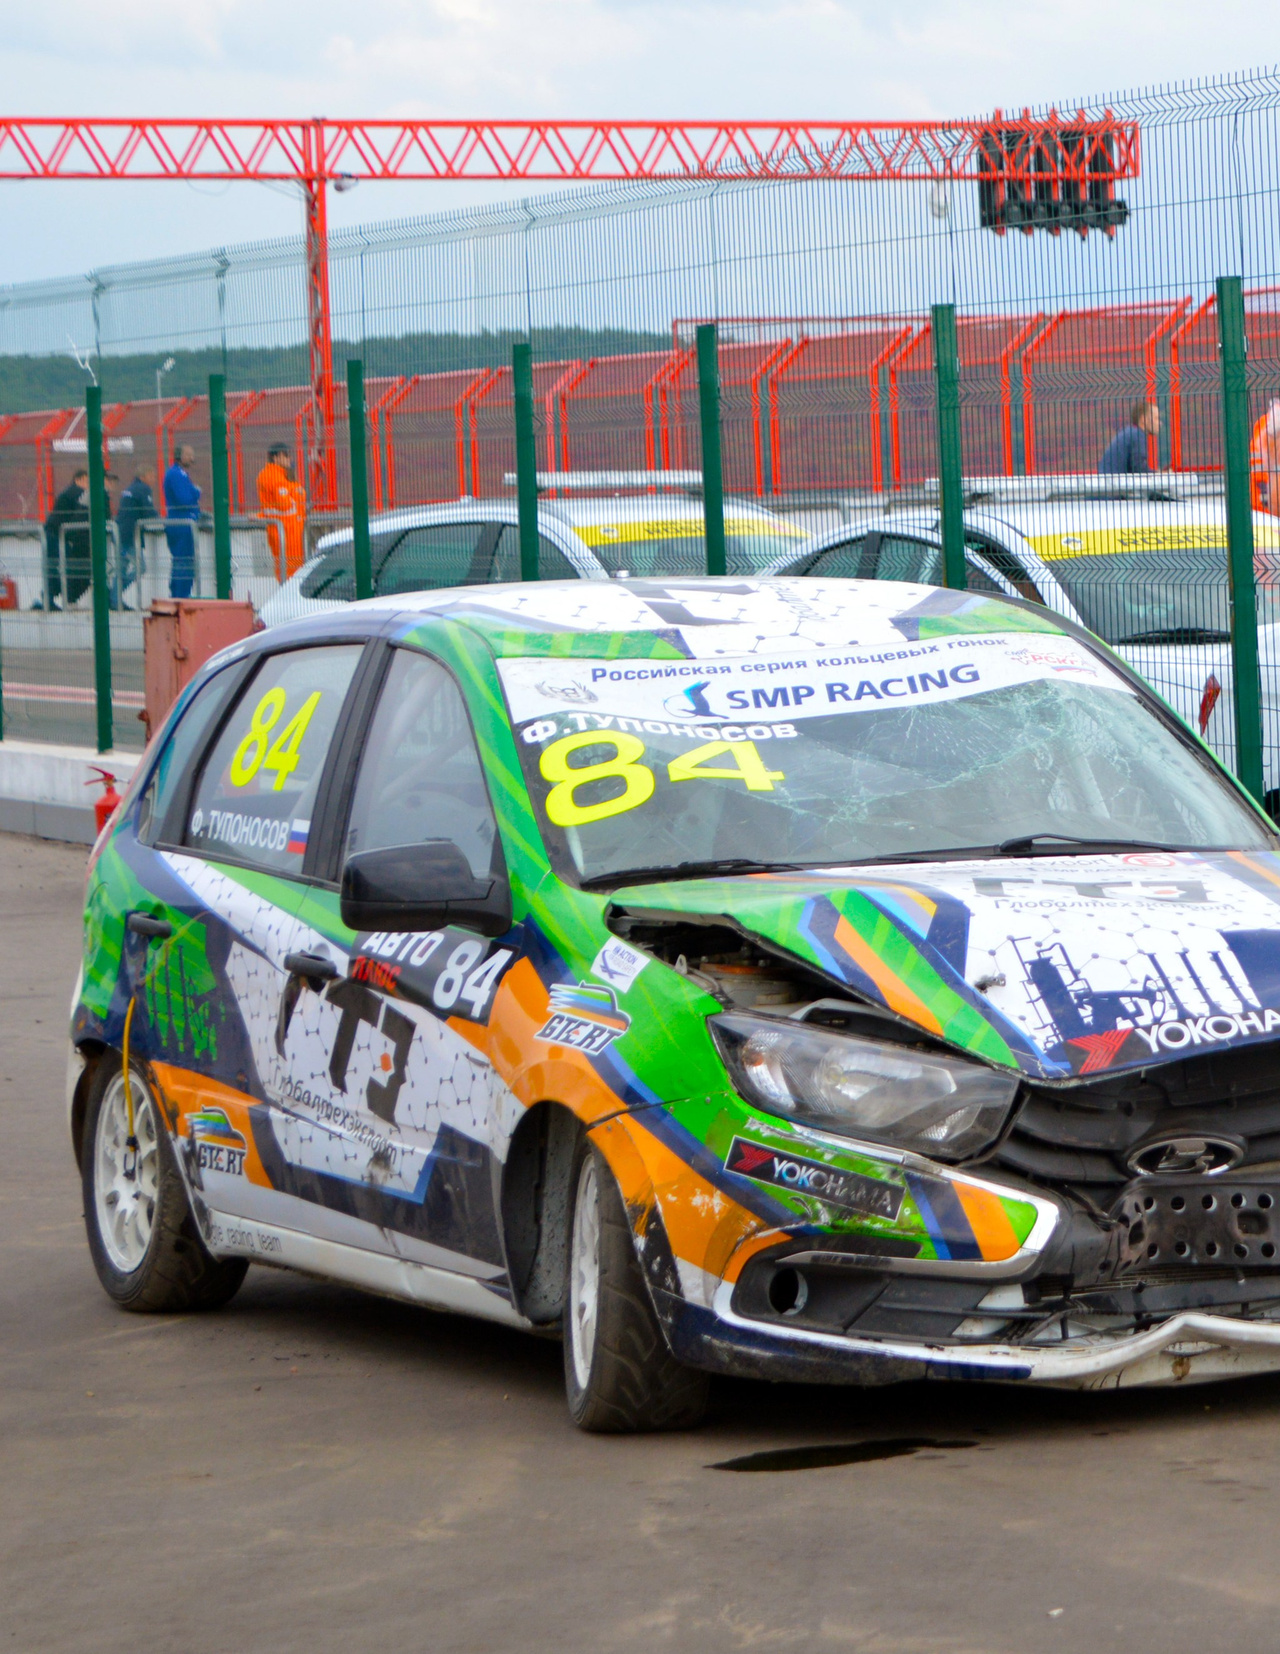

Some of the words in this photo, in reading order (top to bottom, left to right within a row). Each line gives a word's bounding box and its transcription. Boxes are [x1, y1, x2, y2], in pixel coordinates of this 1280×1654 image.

[591, 664, 733, 683] Российская
[740, 659, 808, 675] серия
[816, 643, 940, 668] кольцевых
[946, 637, 1008, 650] гонок
[726, 684, 816, 709] SMP
[825, 663, 981, 703] RACING
[230, 686, 323, 792] 84
[539, 728, 786, 828] 84
[208, 809, 290, 852] ТУПОНОСОВ
[361, 931, 445, 967] АВТО
[433, 939, 513, 1019] 84
